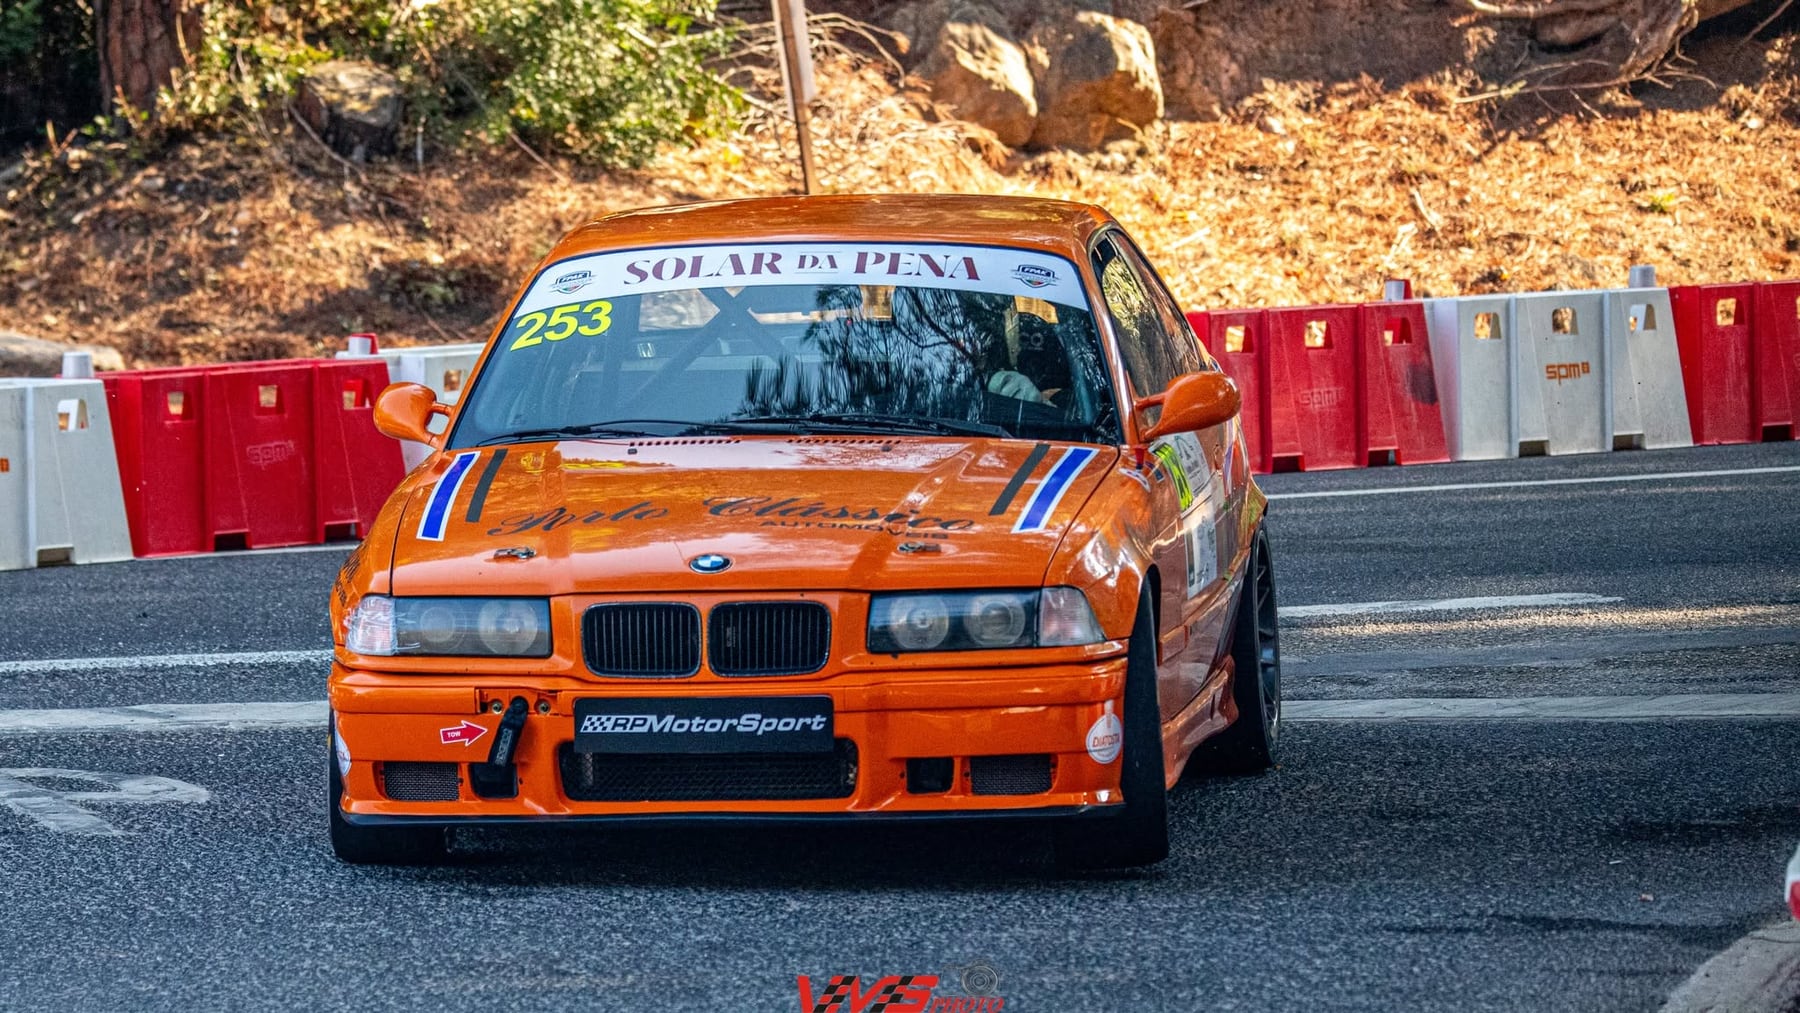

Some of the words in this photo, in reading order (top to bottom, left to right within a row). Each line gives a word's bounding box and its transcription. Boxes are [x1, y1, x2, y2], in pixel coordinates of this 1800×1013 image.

[623, 252, 783, 285] SOLAR
[797, 254, 839, 270] DA
[853, 251, 982, 281] PENA
[510, 300, 613, 352] 253
[487, 501, 669, 536] Porto
